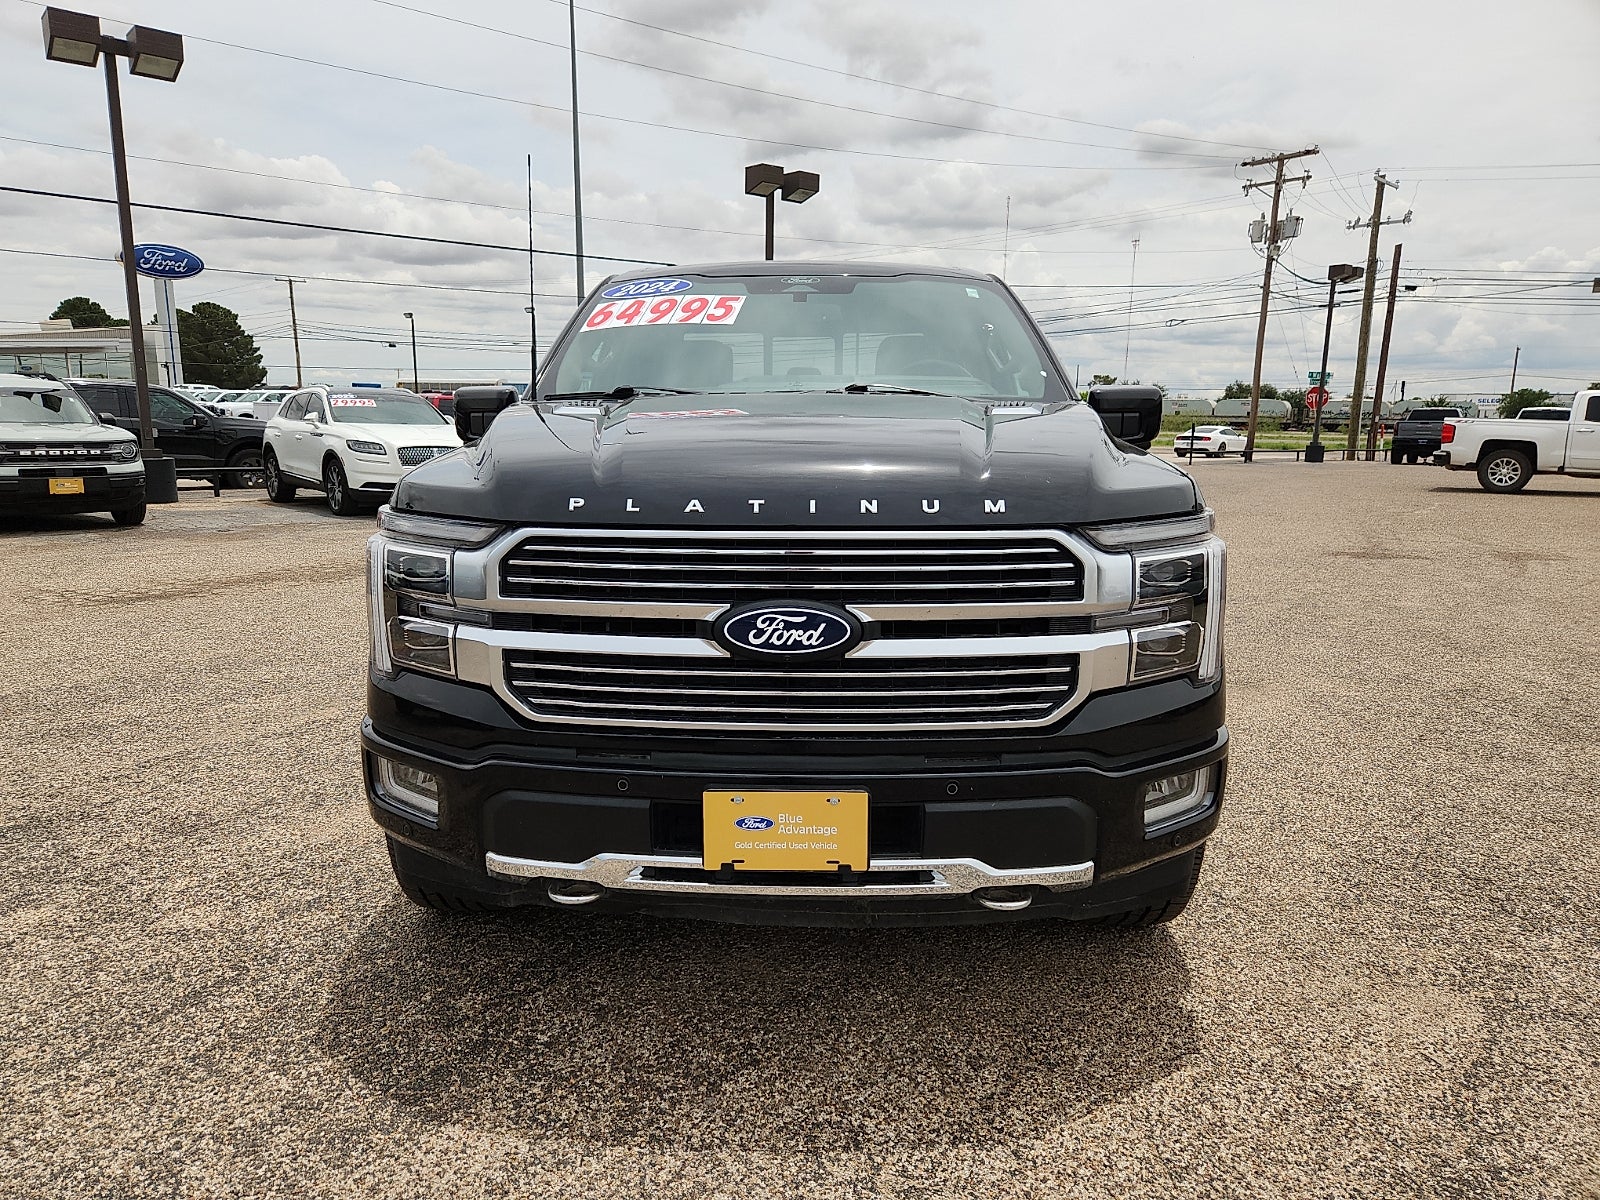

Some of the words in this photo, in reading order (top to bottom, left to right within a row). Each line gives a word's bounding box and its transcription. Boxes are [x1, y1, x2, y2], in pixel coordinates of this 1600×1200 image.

[140, 249, 188, 272] Ford
[619, 278, 675, 295] 2024
[586, 297, 741, 328] 64995
[568, 497, 1006, 514] PLATINUM
[748, 614, 824, 647] Ford
[742, 818, 768, 829] Ford
[778, 813, 803, 823] Blue
[778, 825, 838, 836] Advantage
[734, 841, 753, 849] Gold
[754, 841, 787, 849] Certified
[788, 841, 808, 849] Used
[810, 841, 838, 849] Vehicle
